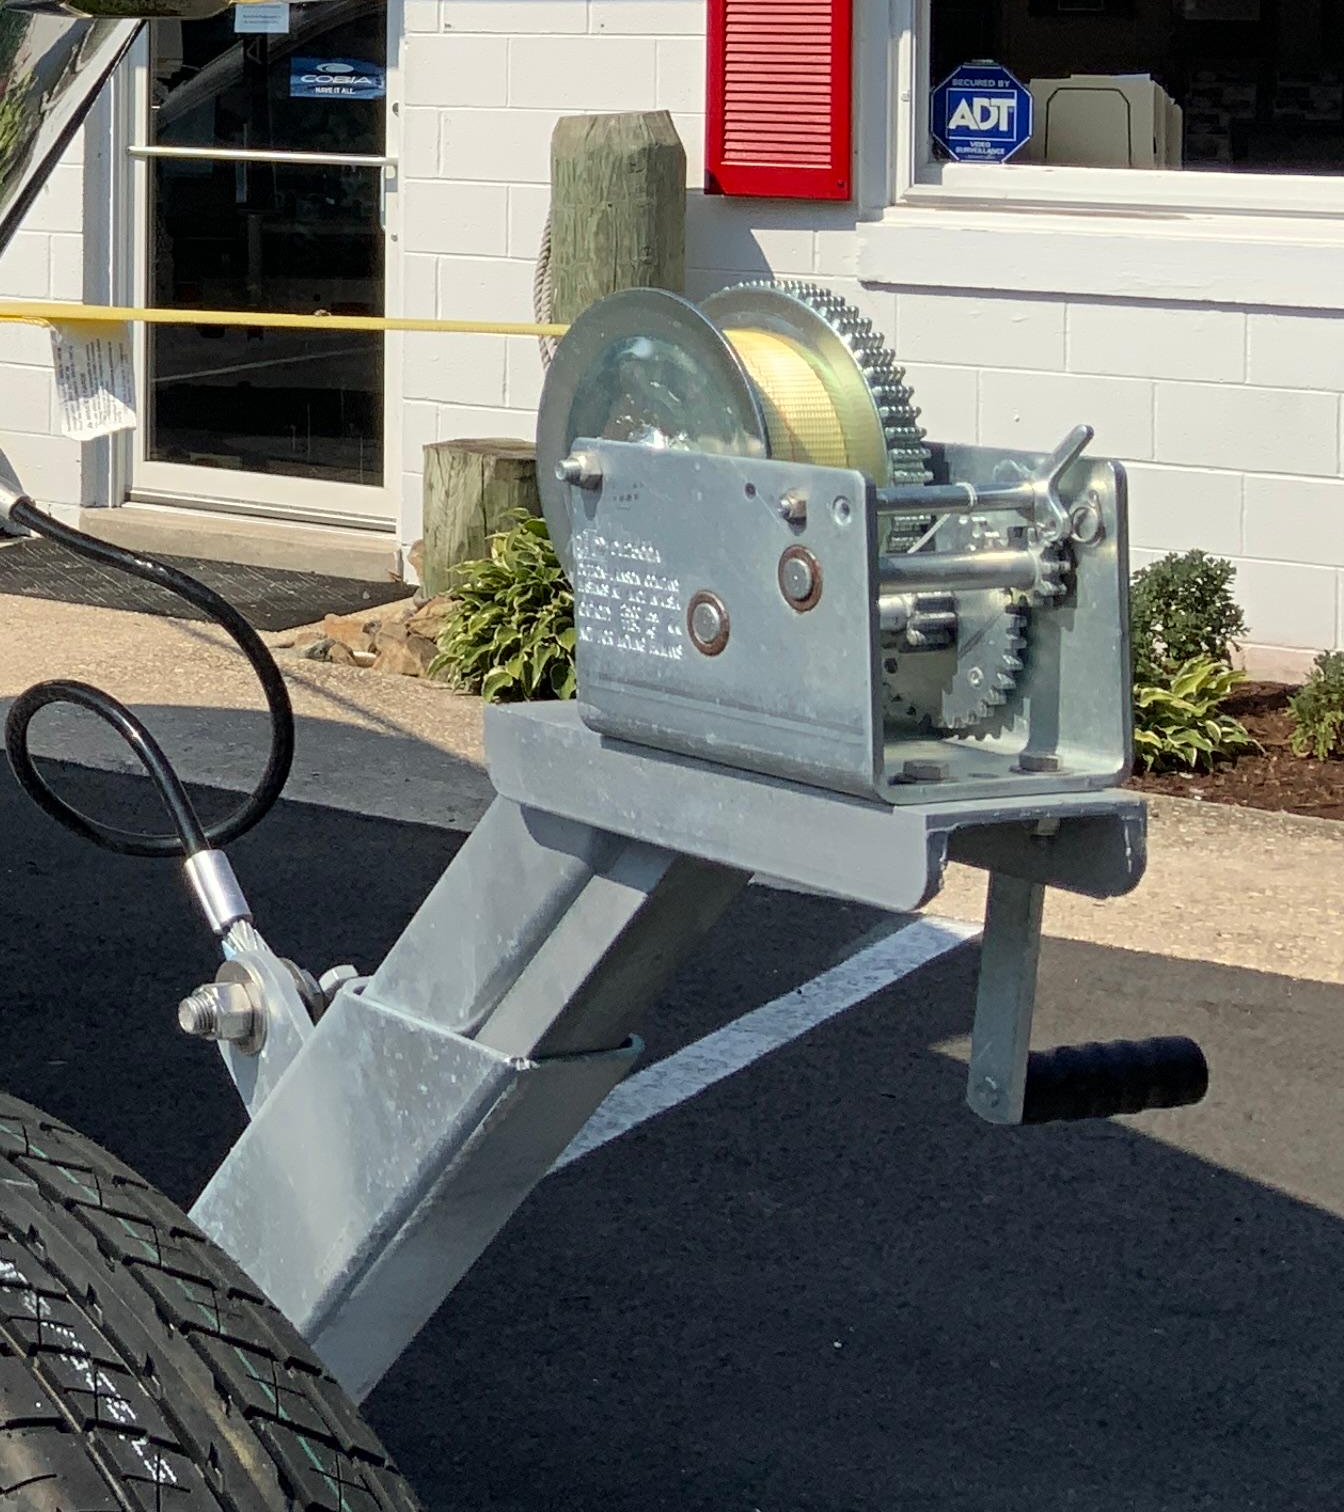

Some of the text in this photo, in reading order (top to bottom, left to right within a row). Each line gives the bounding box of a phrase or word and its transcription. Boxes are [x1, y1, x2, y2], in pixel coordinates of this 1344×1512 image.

[300, 74, 372, 84] COBIA
[952, 78, 1011, 88] SECURED BY
[948, 97, 1016, 131] ADT
